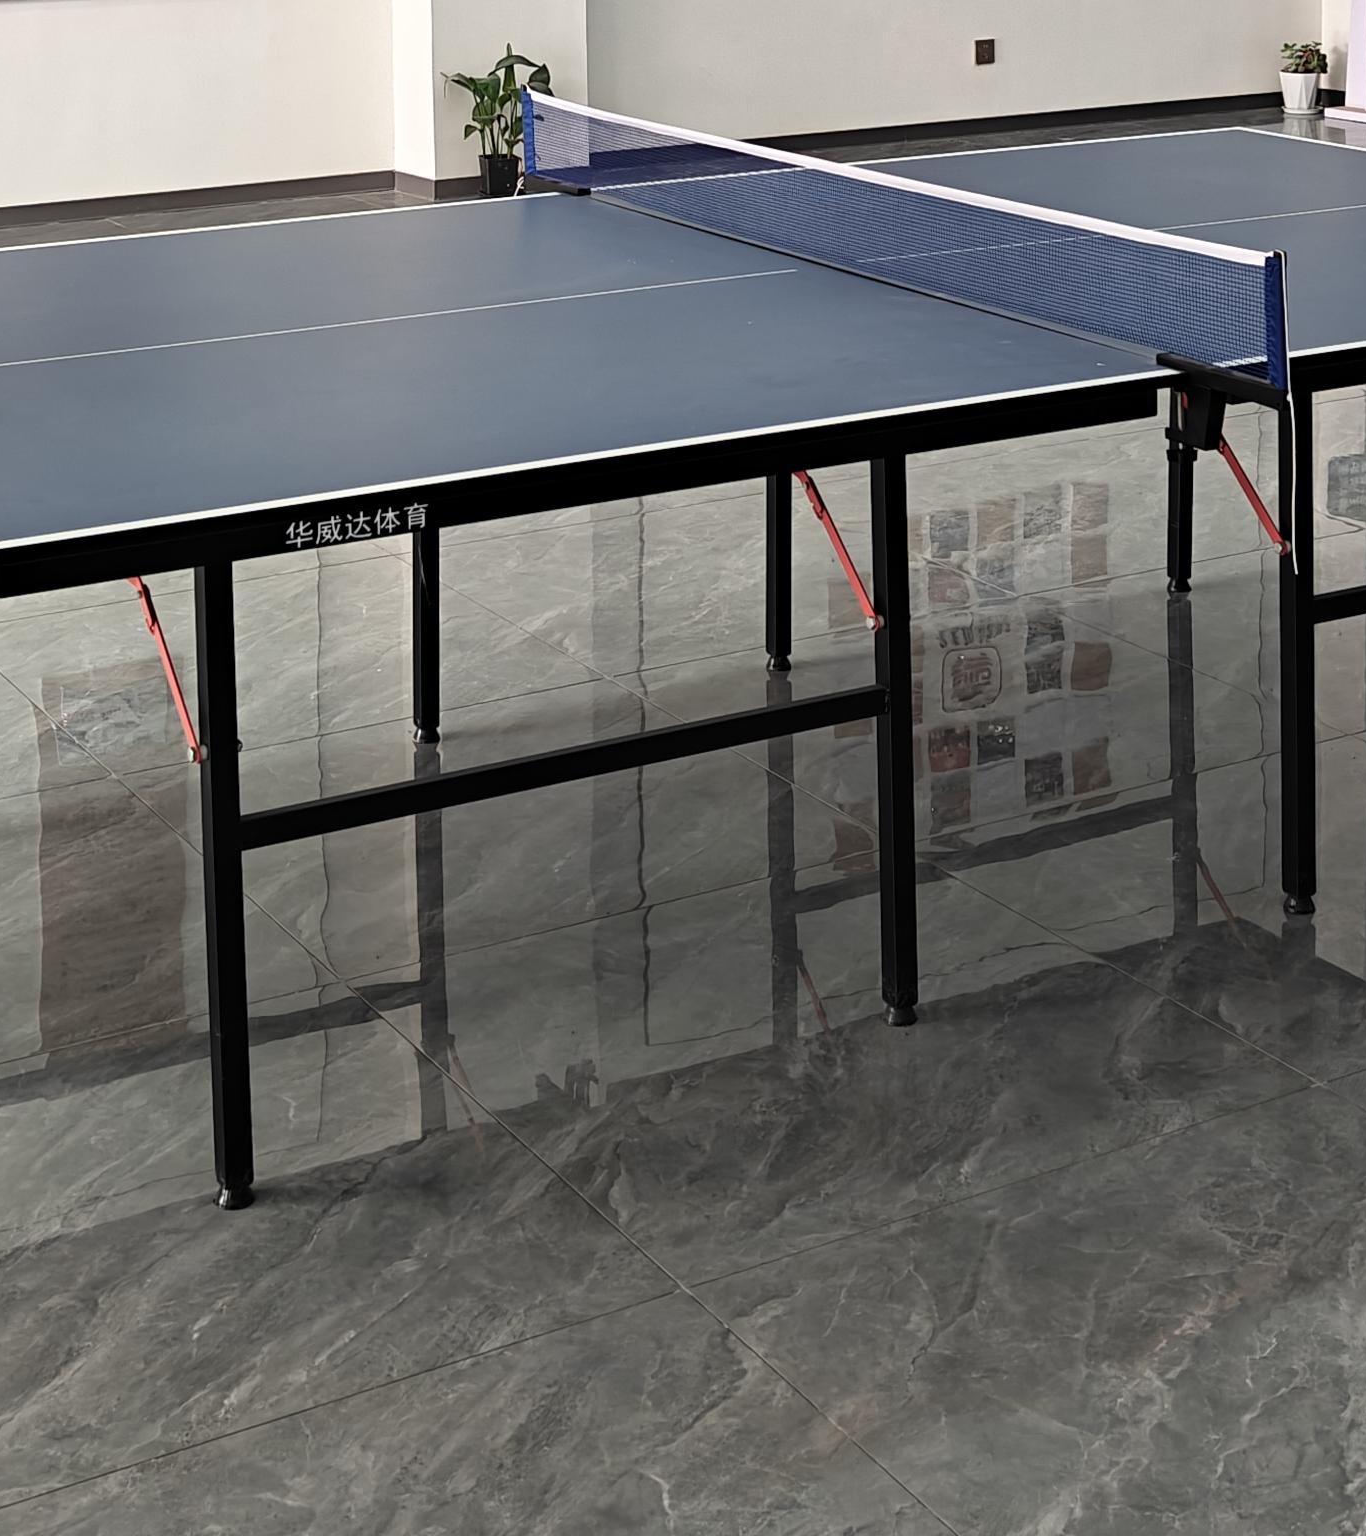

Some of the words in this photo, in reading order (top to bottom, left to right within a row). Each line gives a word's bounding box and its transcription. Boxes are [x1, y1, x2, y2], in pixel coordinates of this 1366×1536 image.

[284, 502, 430, 549] 华威达体育
